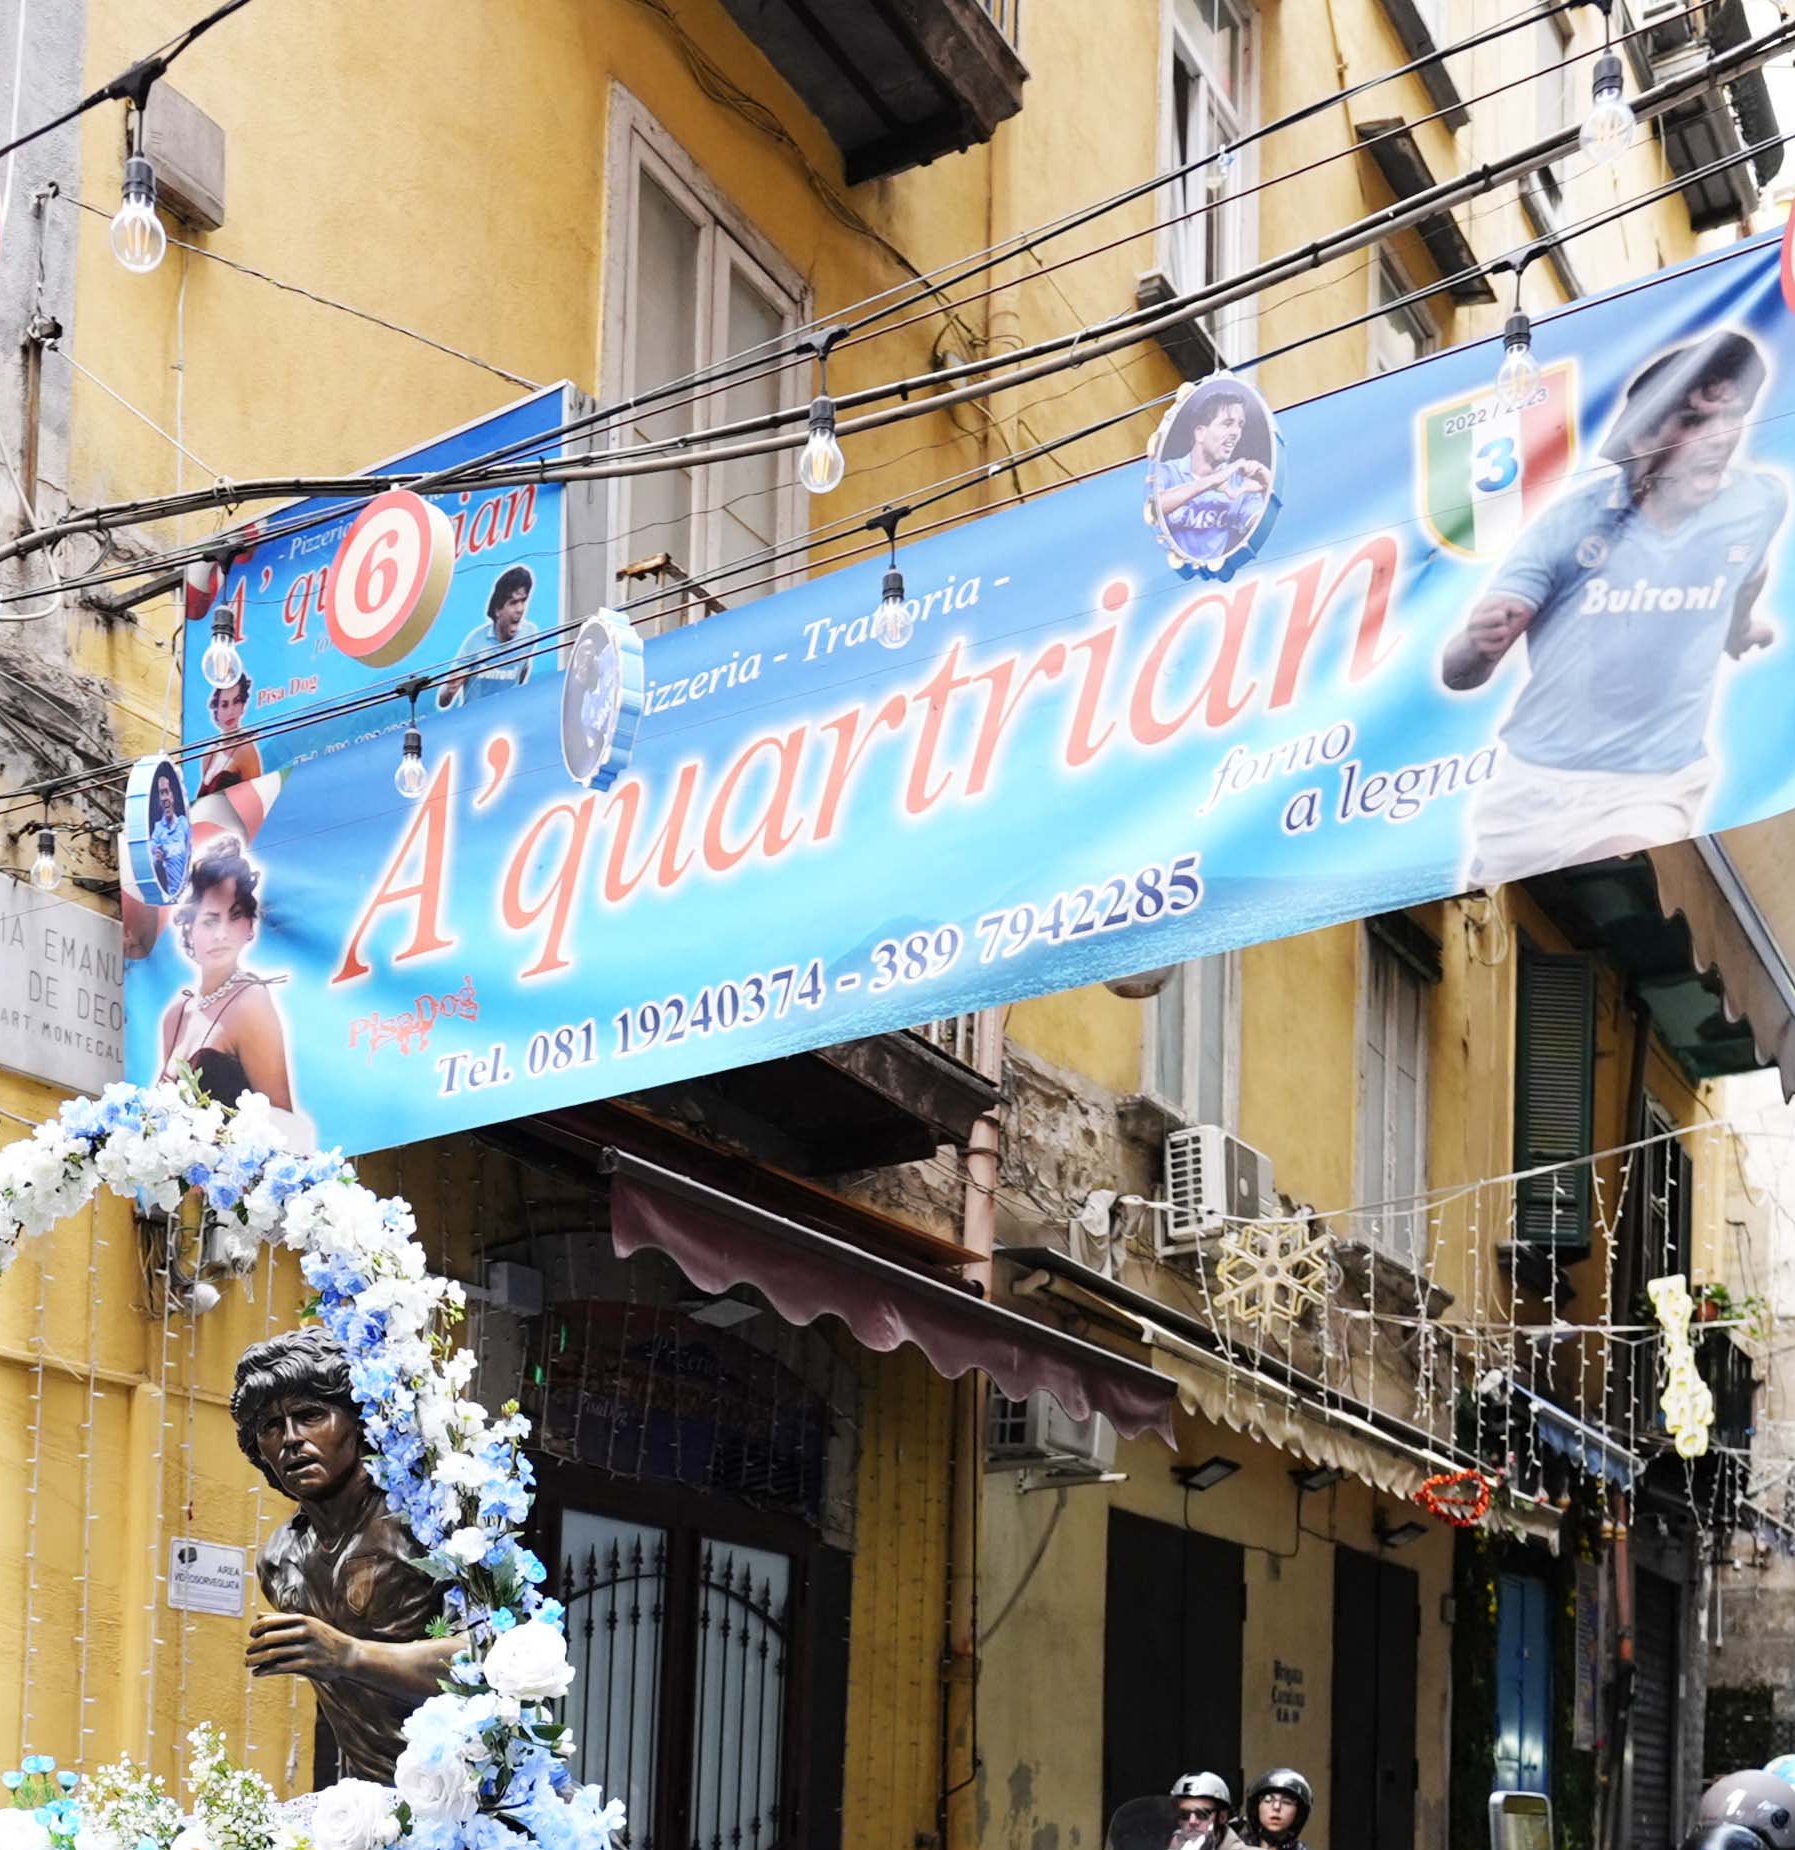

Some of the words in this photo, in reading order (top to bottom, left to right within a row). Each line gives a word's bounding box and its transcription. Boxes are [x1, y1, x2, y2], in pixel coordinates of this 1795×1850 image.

[1445, 408, 1487, 436] 2022
[1475, 436, 1520, 493] 3
[354, 529, 399, 614] 6
[644, 650, 762, 718] izzeria
[330, 536, 1405, 985] A'quartrian
[1198, 723, 1351, 814] forno
[1285, 791, 1318, 832] a
[1340, 744, 1501, 819] legna
[44, 928, 124, 988] EMANU
[438, 1048, 511, 1095] Tel.
[528, 1022, 598, 1075] 081
[616, 961, 822, 1055] 19240374
[872, 928, 960, 992] 389
[980, 856, 1202, 963] 7942285
[28, 970, 60, 1011] DE
[41, 1022, 125, 1066] MONTECAL
[217, 1565, 241, 1577] AREA
